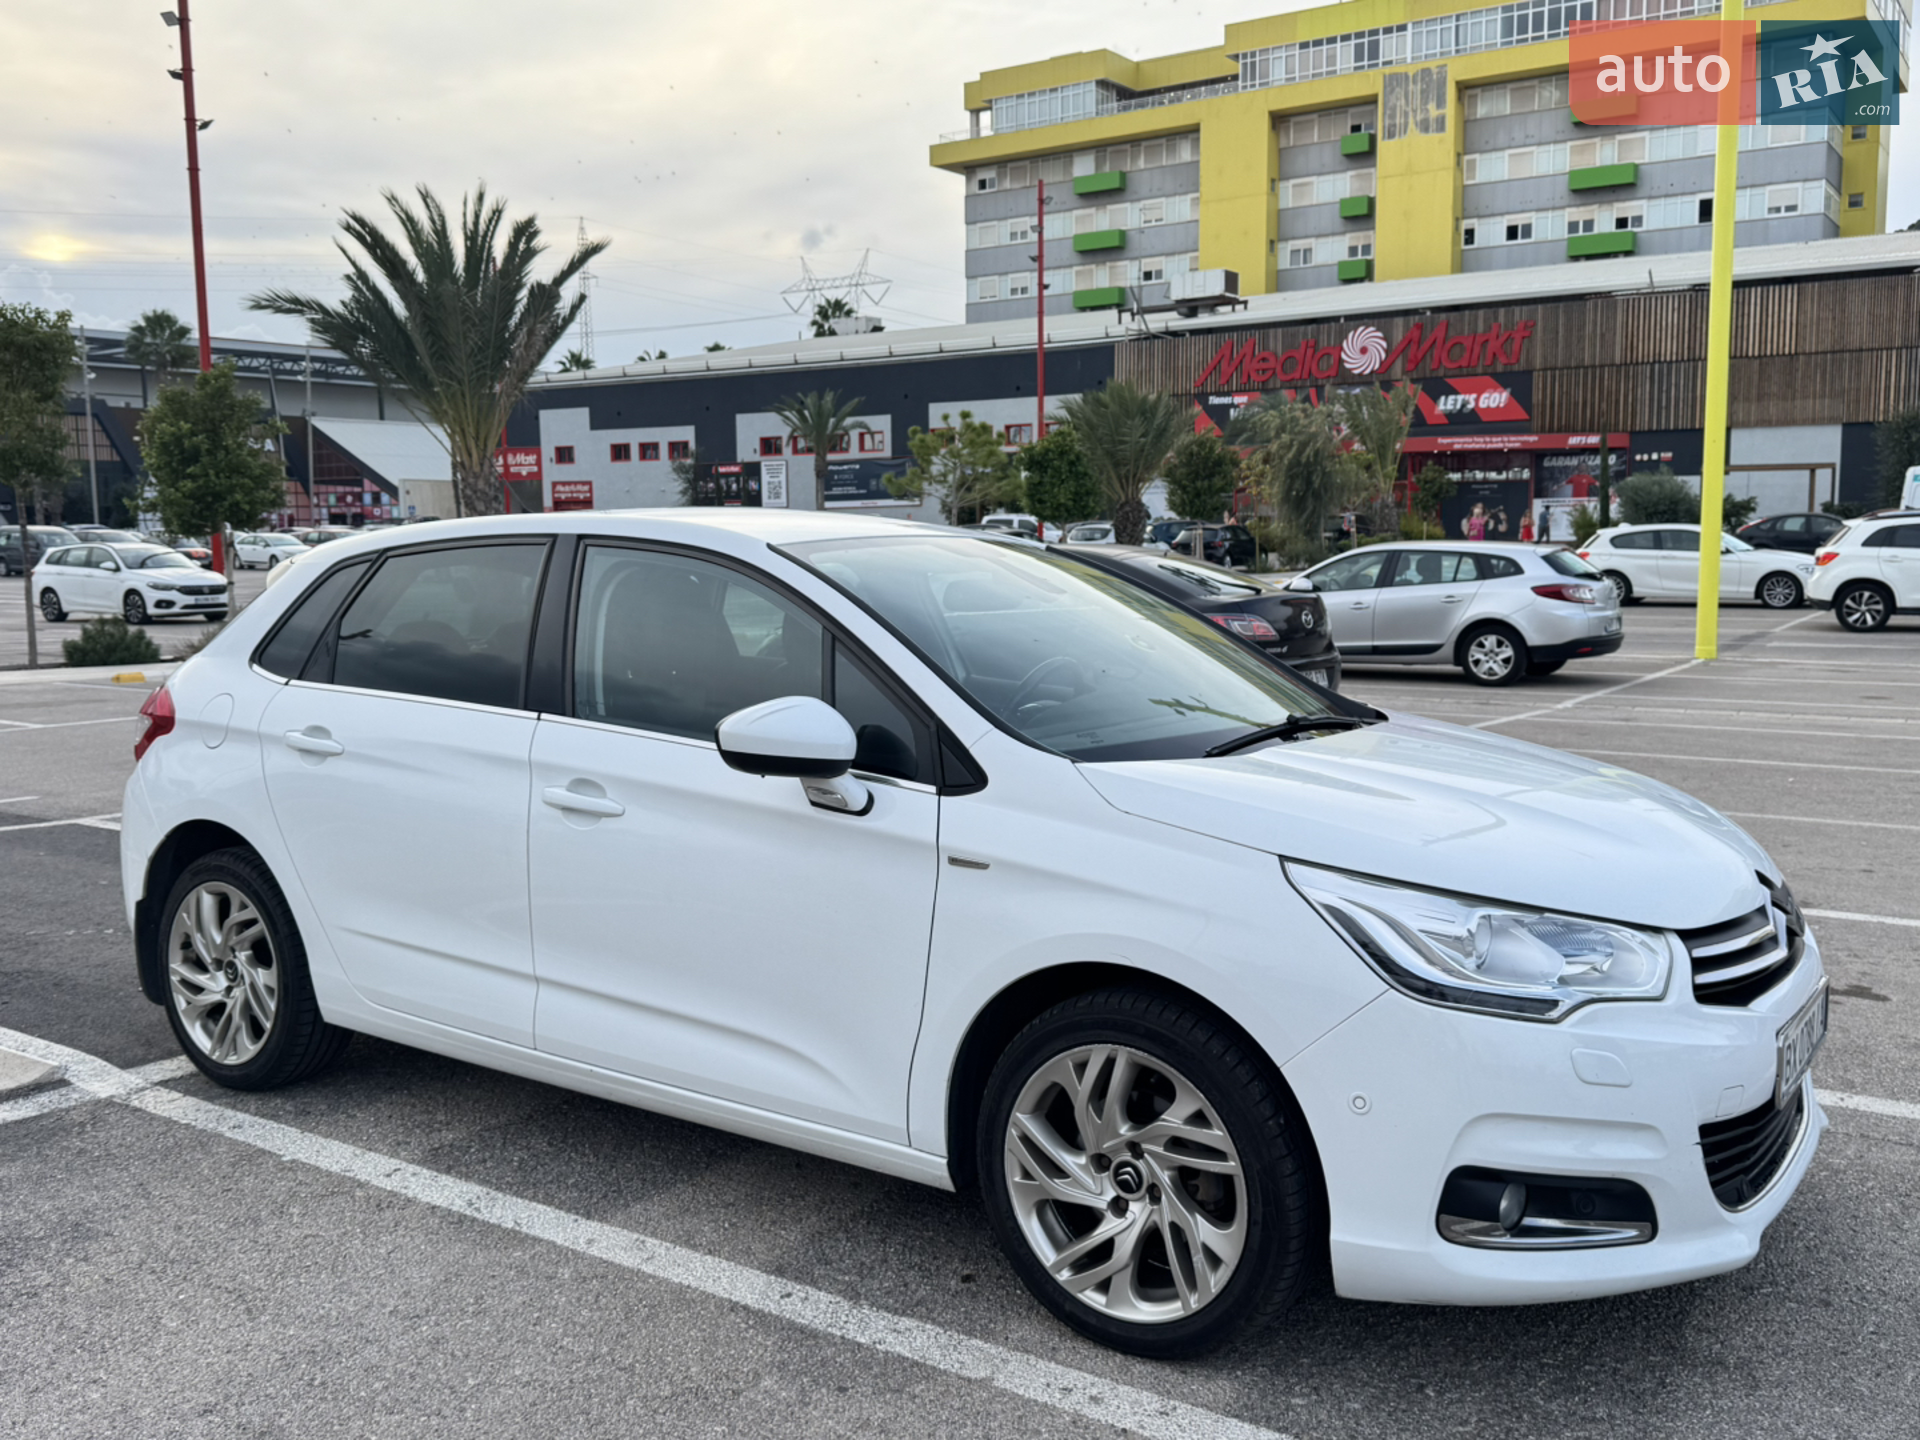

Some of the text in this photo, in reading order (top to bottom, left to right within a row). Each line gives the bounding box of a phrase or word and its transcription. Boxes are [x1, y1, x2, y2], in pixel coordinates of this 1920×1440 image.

[1194, 320, 1534, 388] Media Markt
[1208, 395, 1249, 405] Tienes que
[1438, 390, 1508, 411] LET'S GO!
